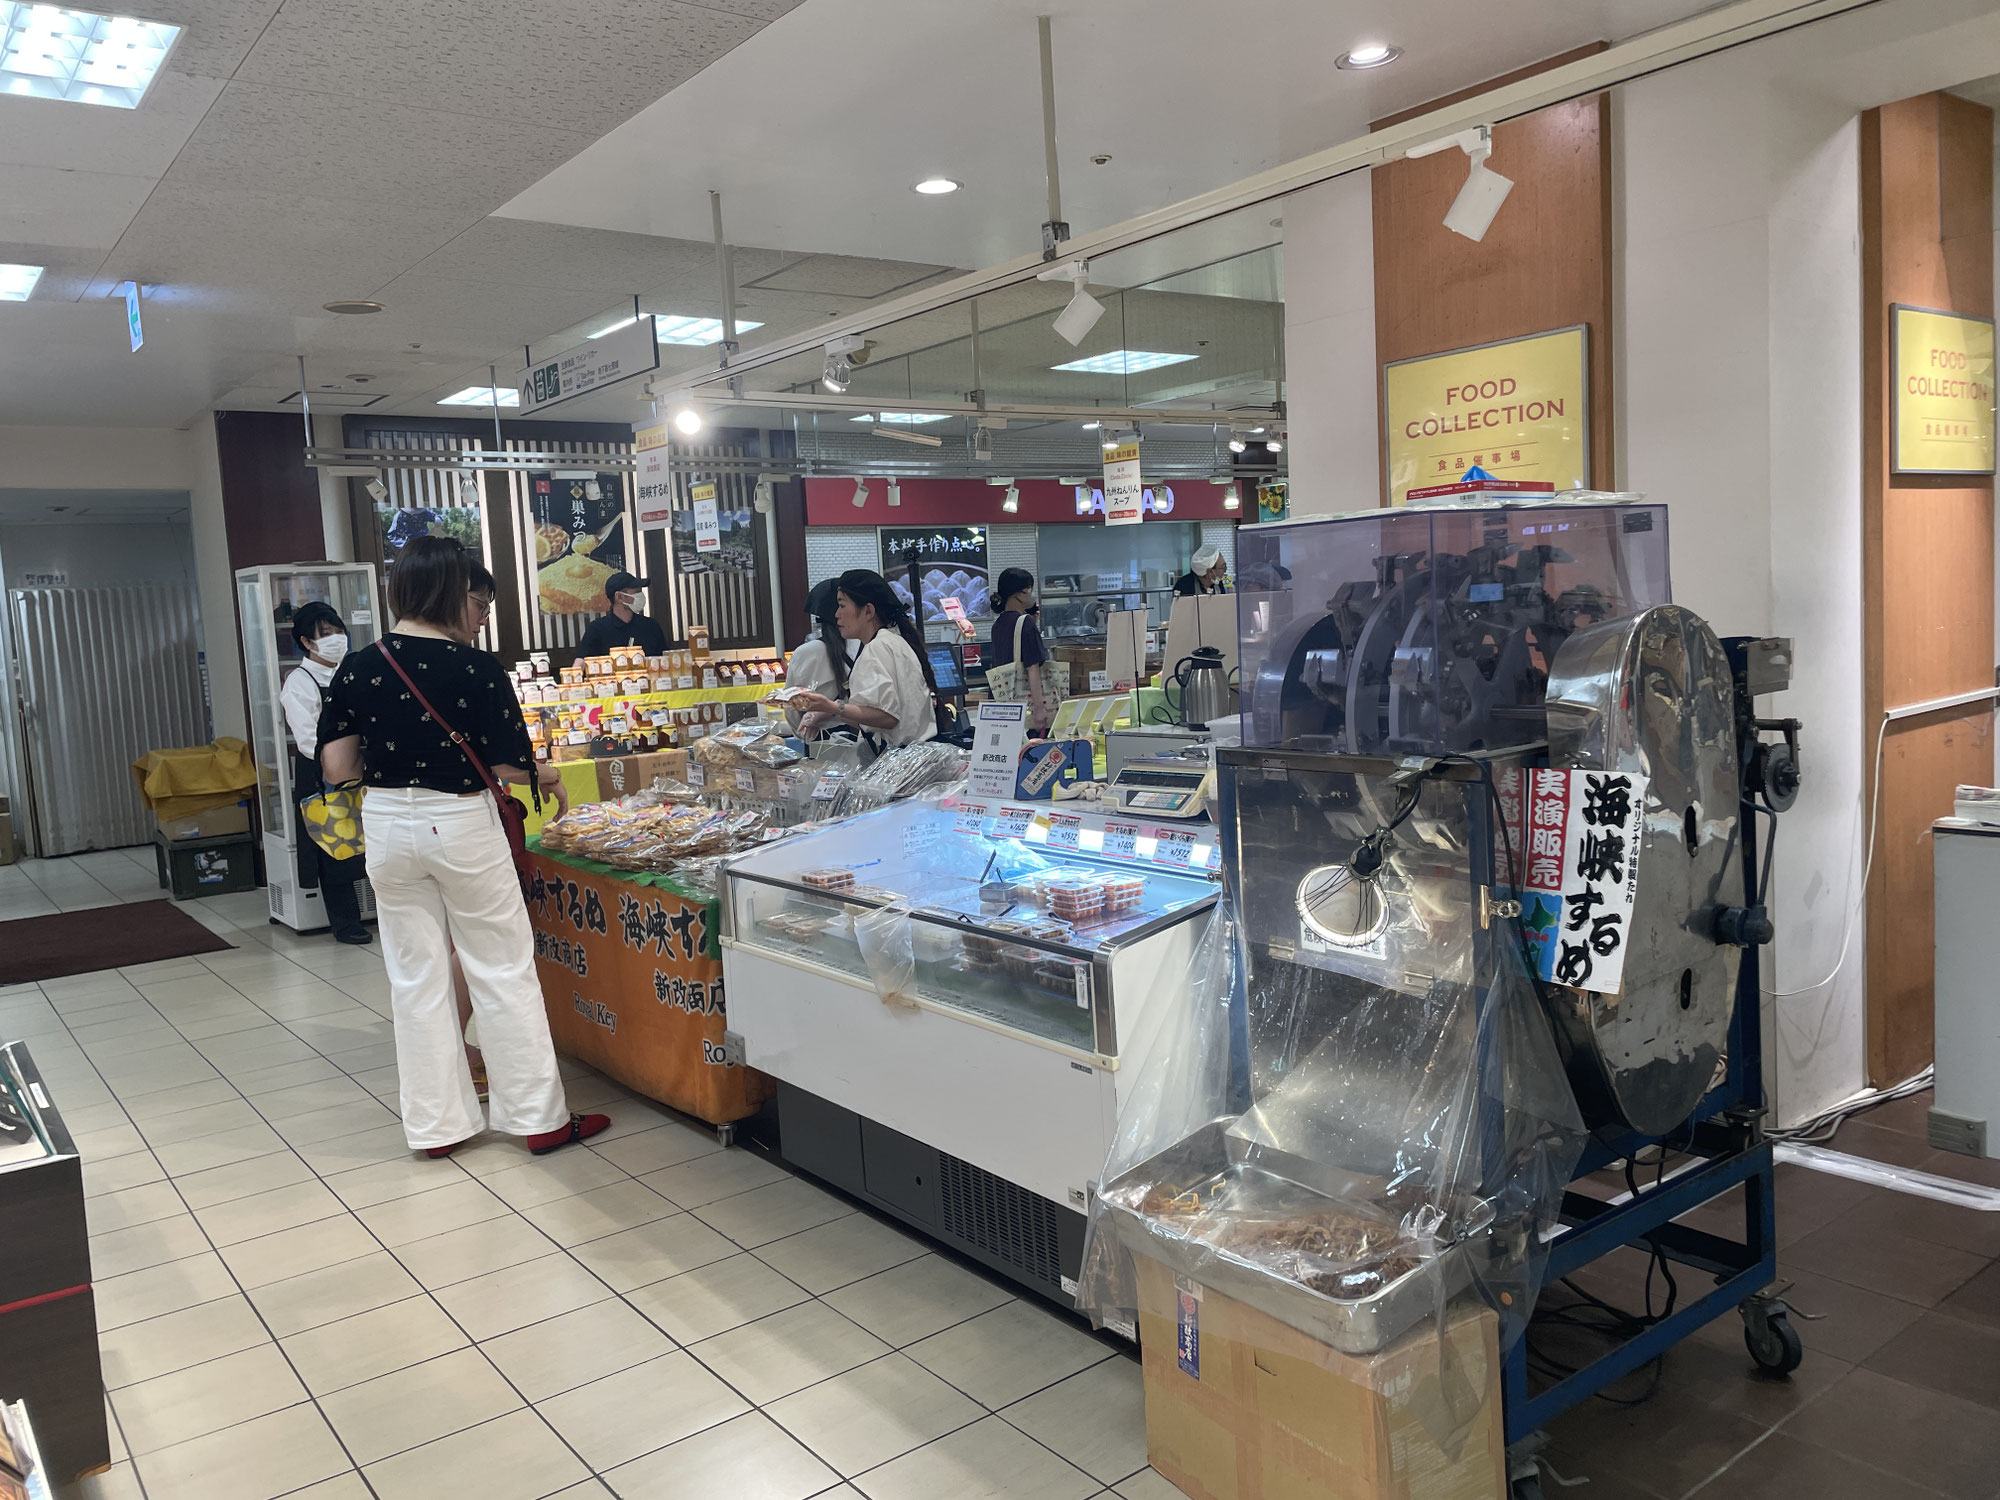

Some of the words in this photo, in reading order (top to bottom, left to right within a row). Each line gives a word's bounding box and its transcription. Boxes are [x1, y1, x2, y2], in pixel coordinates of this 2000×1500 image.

[1931, 349, 1968, 369] FOOD
[1446, 378, 1517, 405] FOOD
[1907, 376, 1987, 401] COLLECTION
[1405, 399, 1565, 439] COLLECTION
[1437, 450, 1521, 471] 食品催事場
[639, 482, 669, 500] 海峡するめ
[1114, 496, 1130, 506] スープ
[571, 499, 586, 551] 巣みつ
[982, 753, 1008, 763] 新改商店
[609, 759, 626, 796] 国産
[1531, 768, 1566, 887] 実演販売
[1170, 848, 1191, 858] ¥1512
[1625, 798, 1643, 904] オリジナル特製たれ
[1557, 773, 1632, 987] 海峡するめ
[536, 929, 588, 978] 新改商店
[573, 992, 595, 1024] Royal
[596, 1002, 617, 1035] Key
